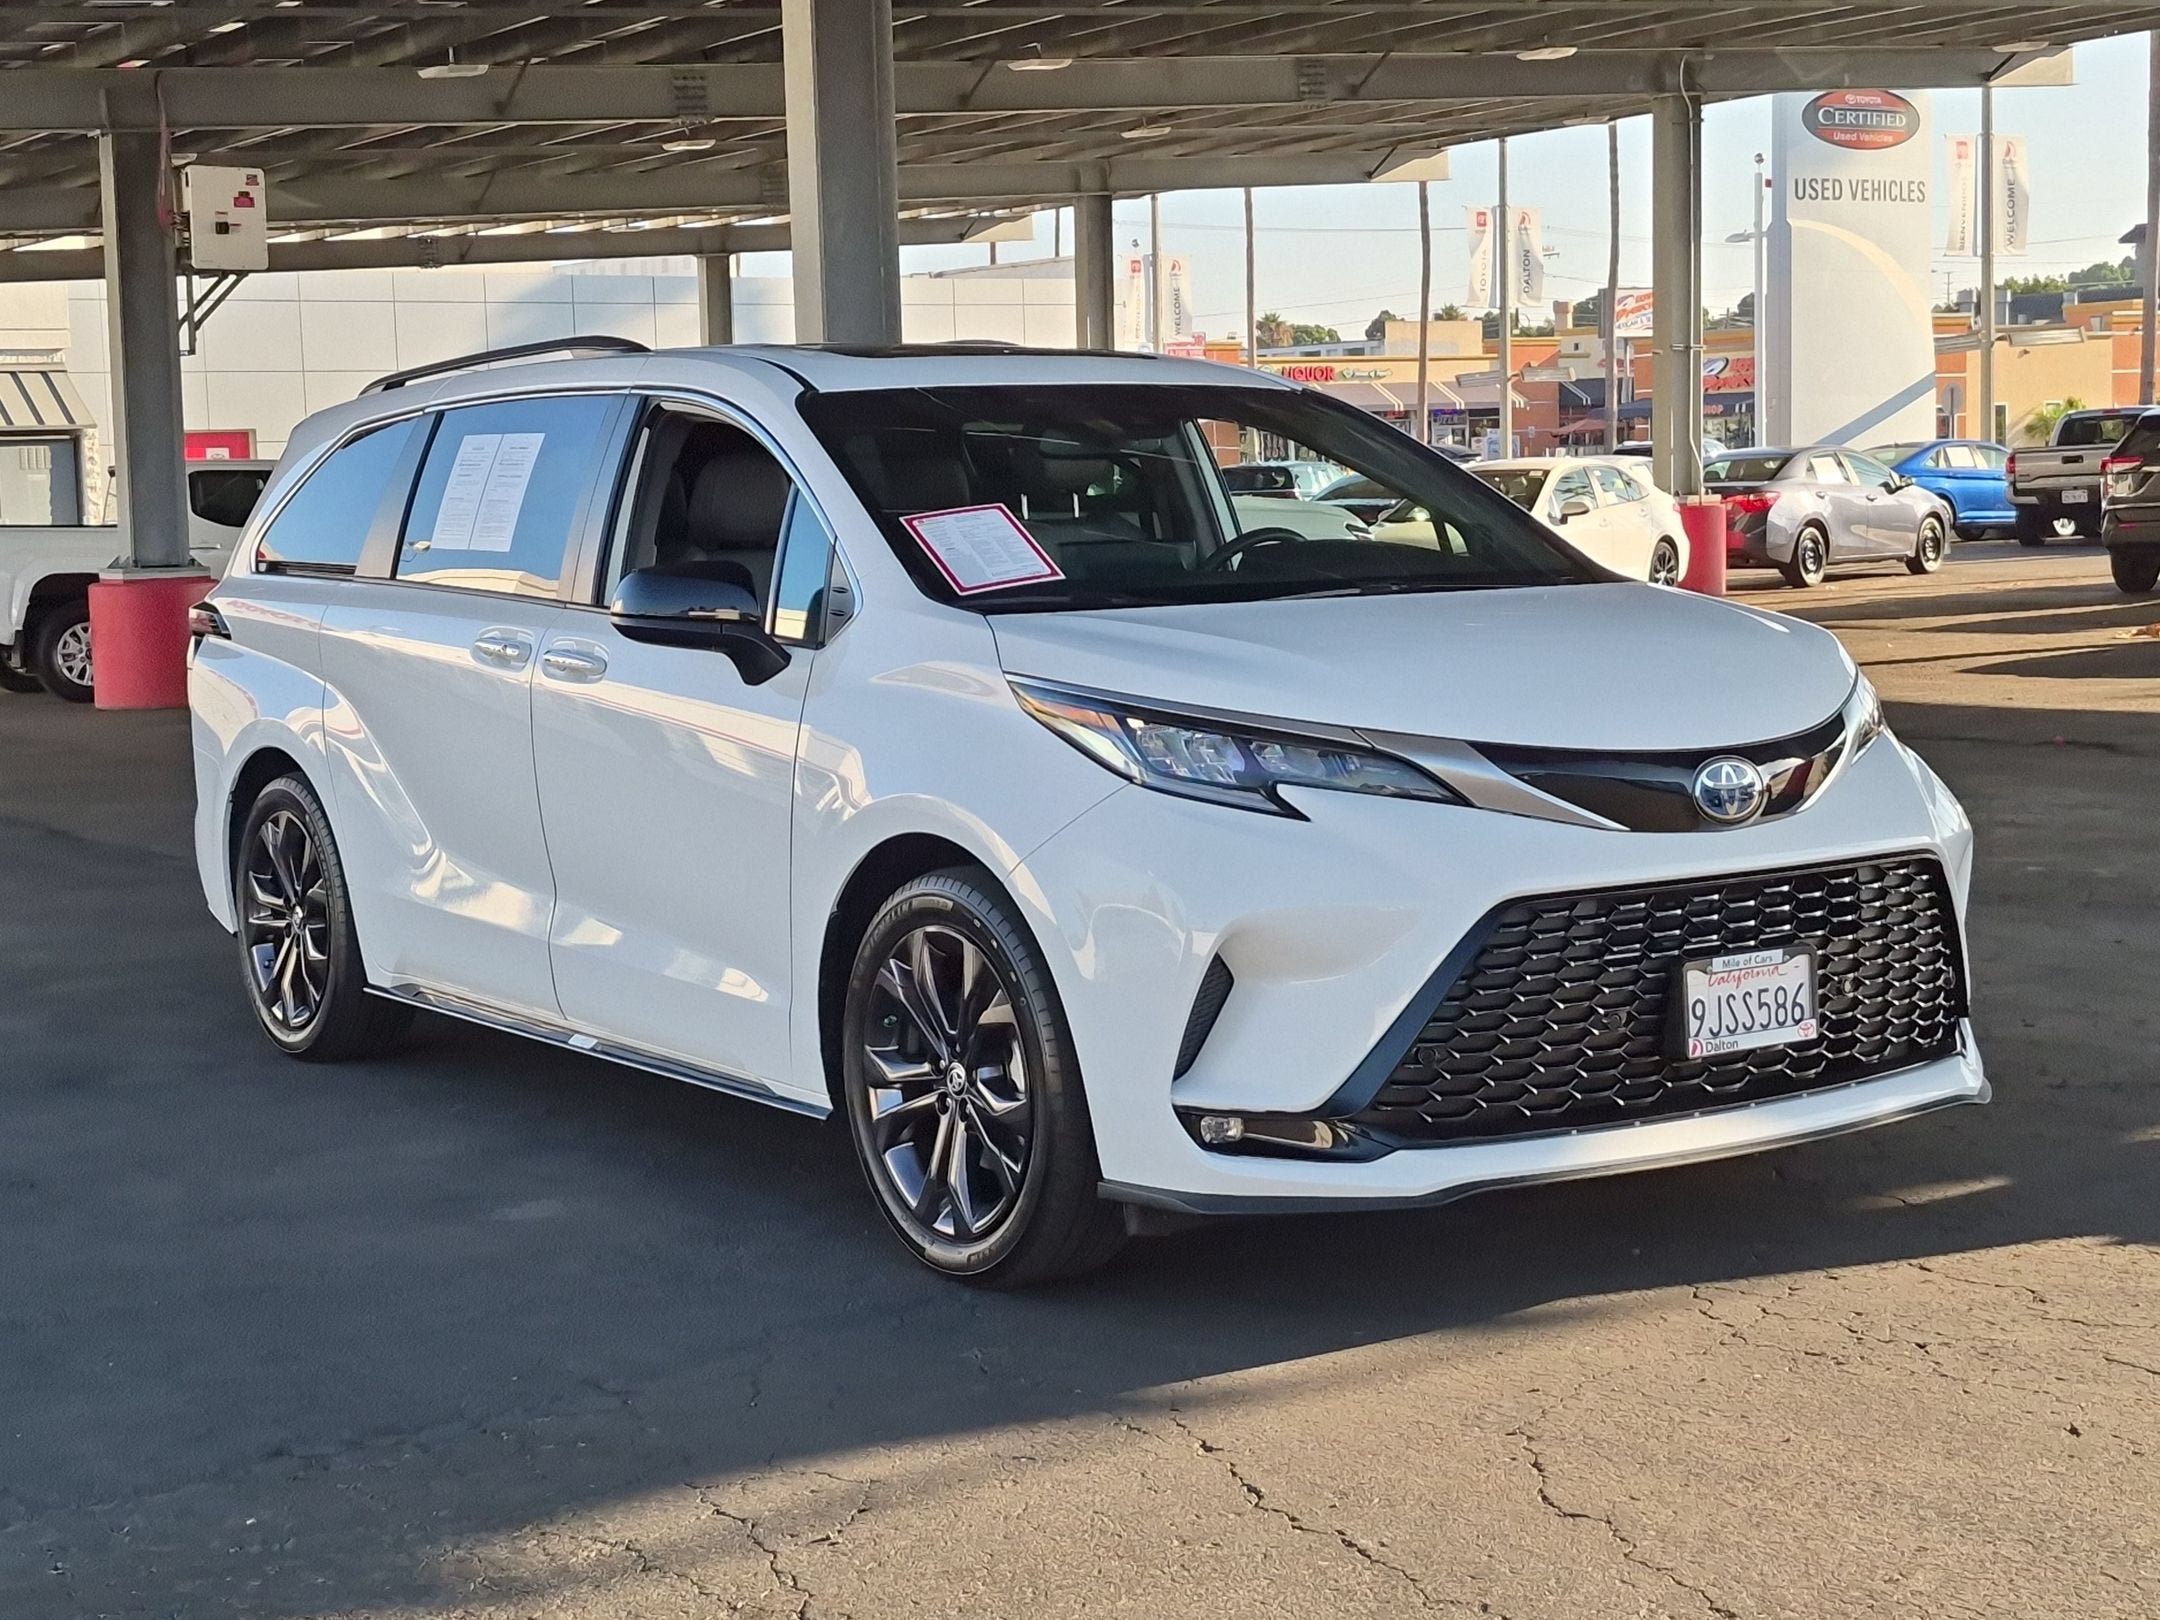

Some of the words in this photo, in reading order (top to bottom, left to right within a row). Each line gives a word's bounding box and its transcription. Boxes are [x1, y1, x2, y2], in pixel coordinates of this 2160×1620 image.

[1817, 107, 1907, 127] CERTIFIED
[1833, 131, 1857, 141] Used
[1859, 132, 1894, 143] Vehicles
[1793, 177, 1843, 201] USED
[1848, 178, 1927, 203] VEHICLES
[2005, 178, 2017, 247] WELCOME
[1522, 249, 1532, 294] DALTON
[1173, 287, 1182, 336] WELCOME
[1721, 959, 1740, 969] Mile
[1743, 957, 1752, 966] of
[1754, 954, 1773, 965] Cars
[1692, 982, 1806, 1037] 9JSS586
[1705, 1038, 1739, 1053] Dalton
